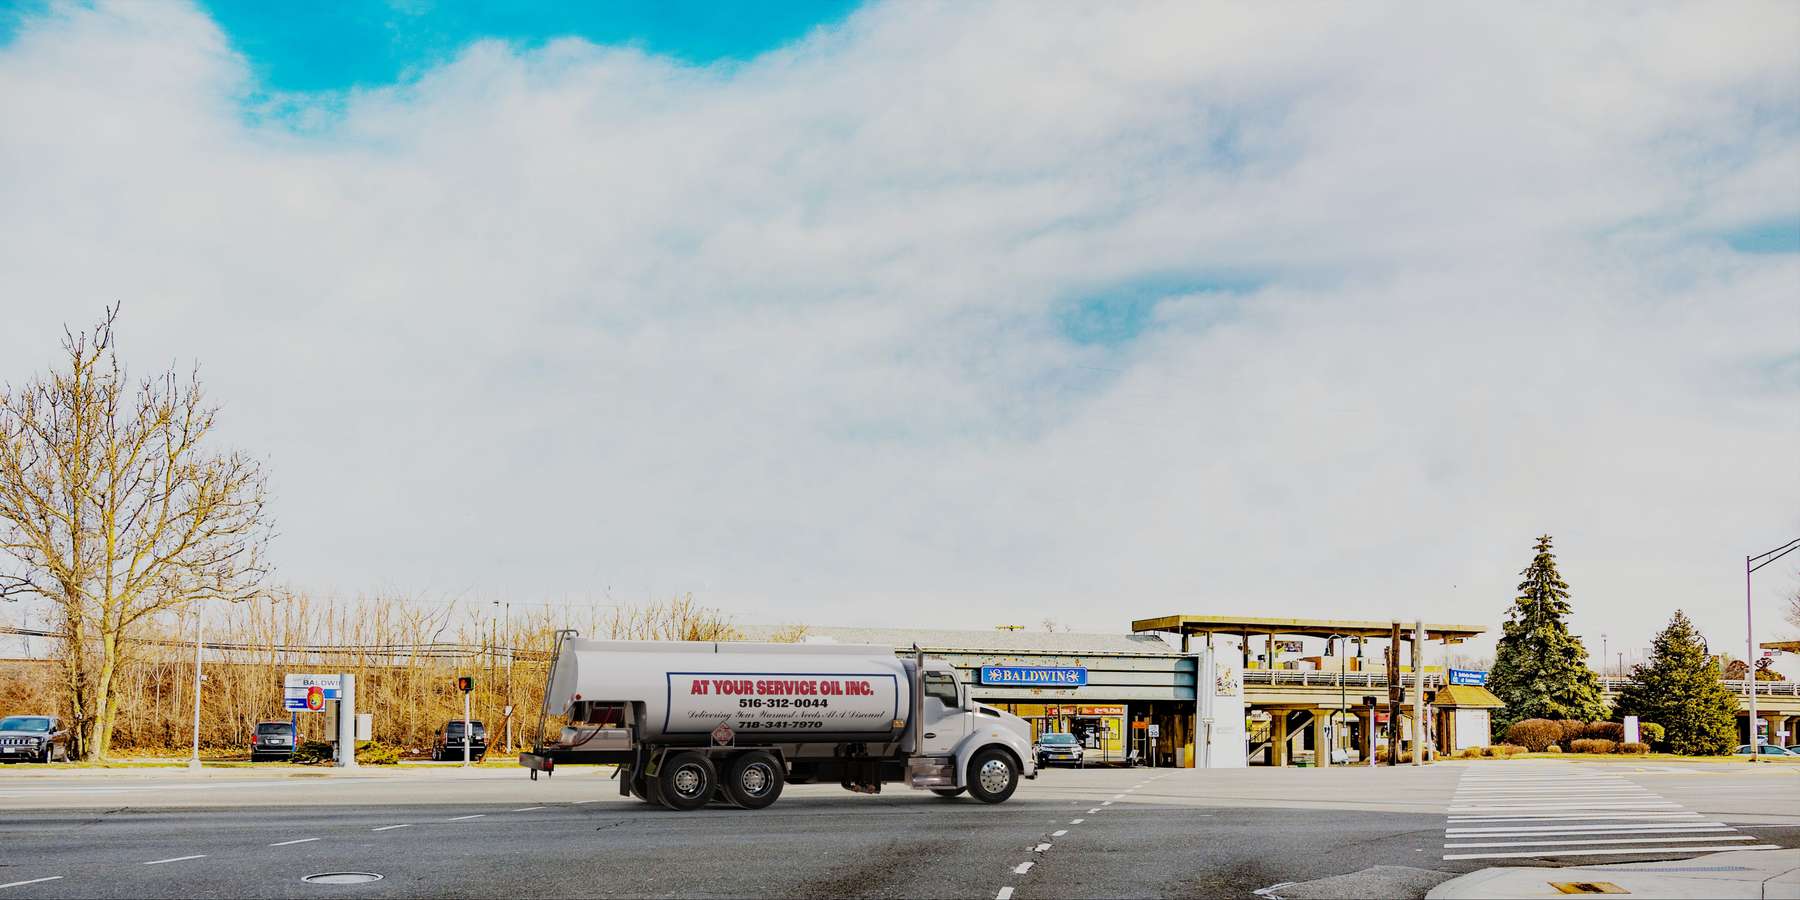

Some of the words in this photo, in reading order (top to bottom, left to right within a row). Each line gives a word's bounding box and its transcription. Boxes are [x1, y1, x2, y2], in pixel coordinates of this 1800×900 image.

[1003, 670, 1066, 682] BALDWIN
[690, 679, 710, 695] AT
[712, 679, 754, 695] YOUR
[756, 680, 817, 696] SERVICE
[820, 680, 843, 696] OIL
[845, 680, 874, 696] INC.
[739, 698, 828, 708] 516-312-0044
[687, 710, 732, 721] Delivering
[735, 710, 755, 719] Your
[798, 710, 821, 719] Needs
[823, 710, 836, 719] At
[848, 710, 886, 719] Discount
[738, 721, 823, 729] 718-341-7970
